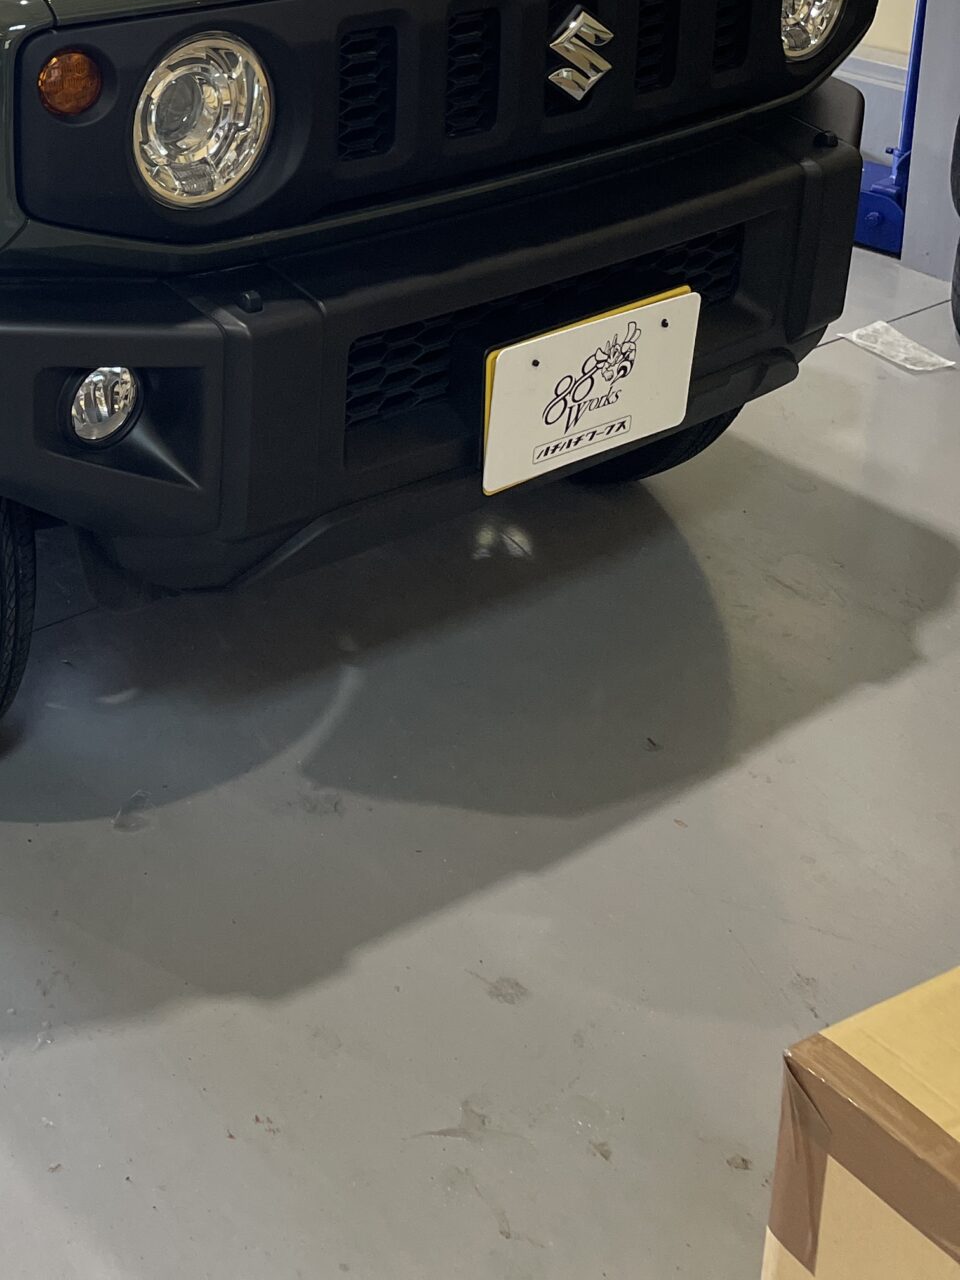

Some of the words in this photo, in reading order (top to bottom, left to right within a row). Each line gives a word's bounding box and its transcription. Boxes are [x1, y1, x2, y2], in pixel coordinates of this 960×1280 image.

[564, 385, 623, 435] Works
[536, 420, 627, 460] ハチハチワークス
